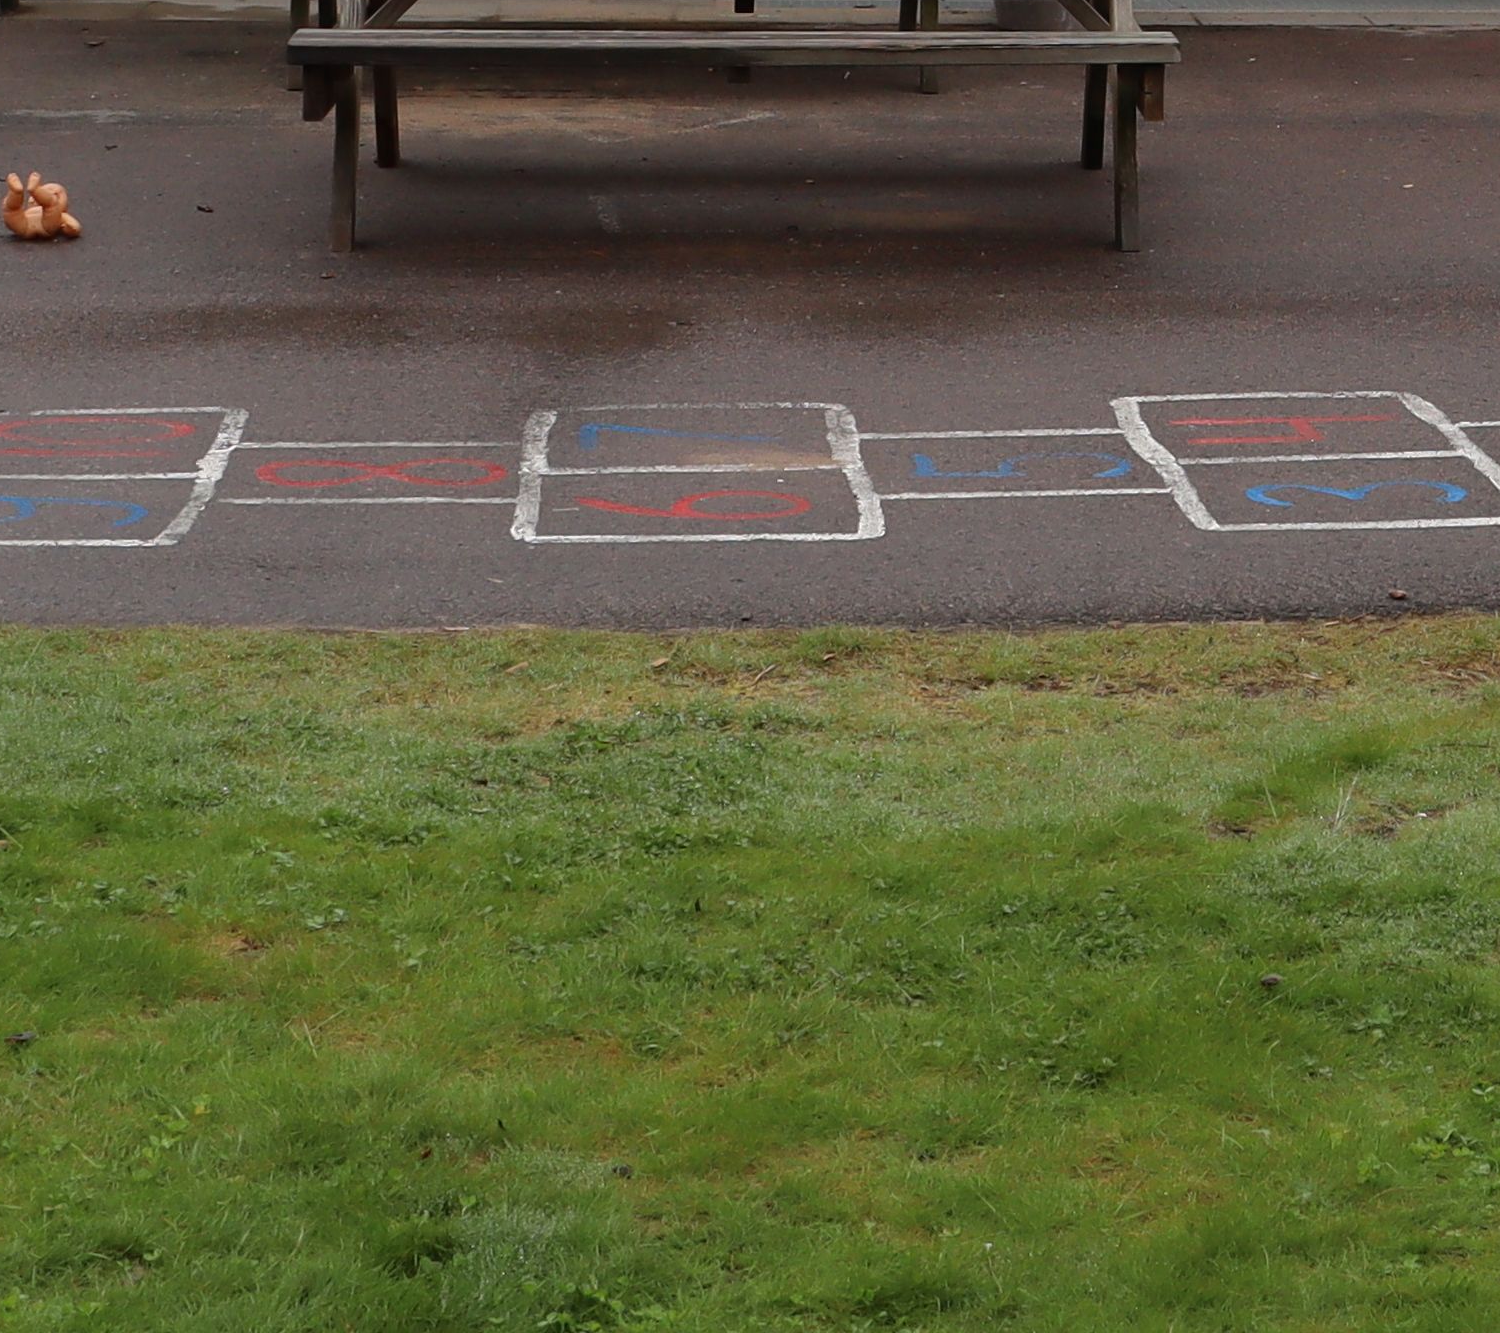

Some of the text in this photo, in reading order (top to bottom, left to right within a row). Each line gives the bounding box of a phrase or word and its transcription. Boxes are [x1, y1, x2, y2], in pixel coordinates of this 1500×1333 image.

[255, 458, 509, 488] 8
[910, 452, 1132, 478] 5
[573, 489, 811, 521] 6
[1244, 478, 1468, 508] 3
